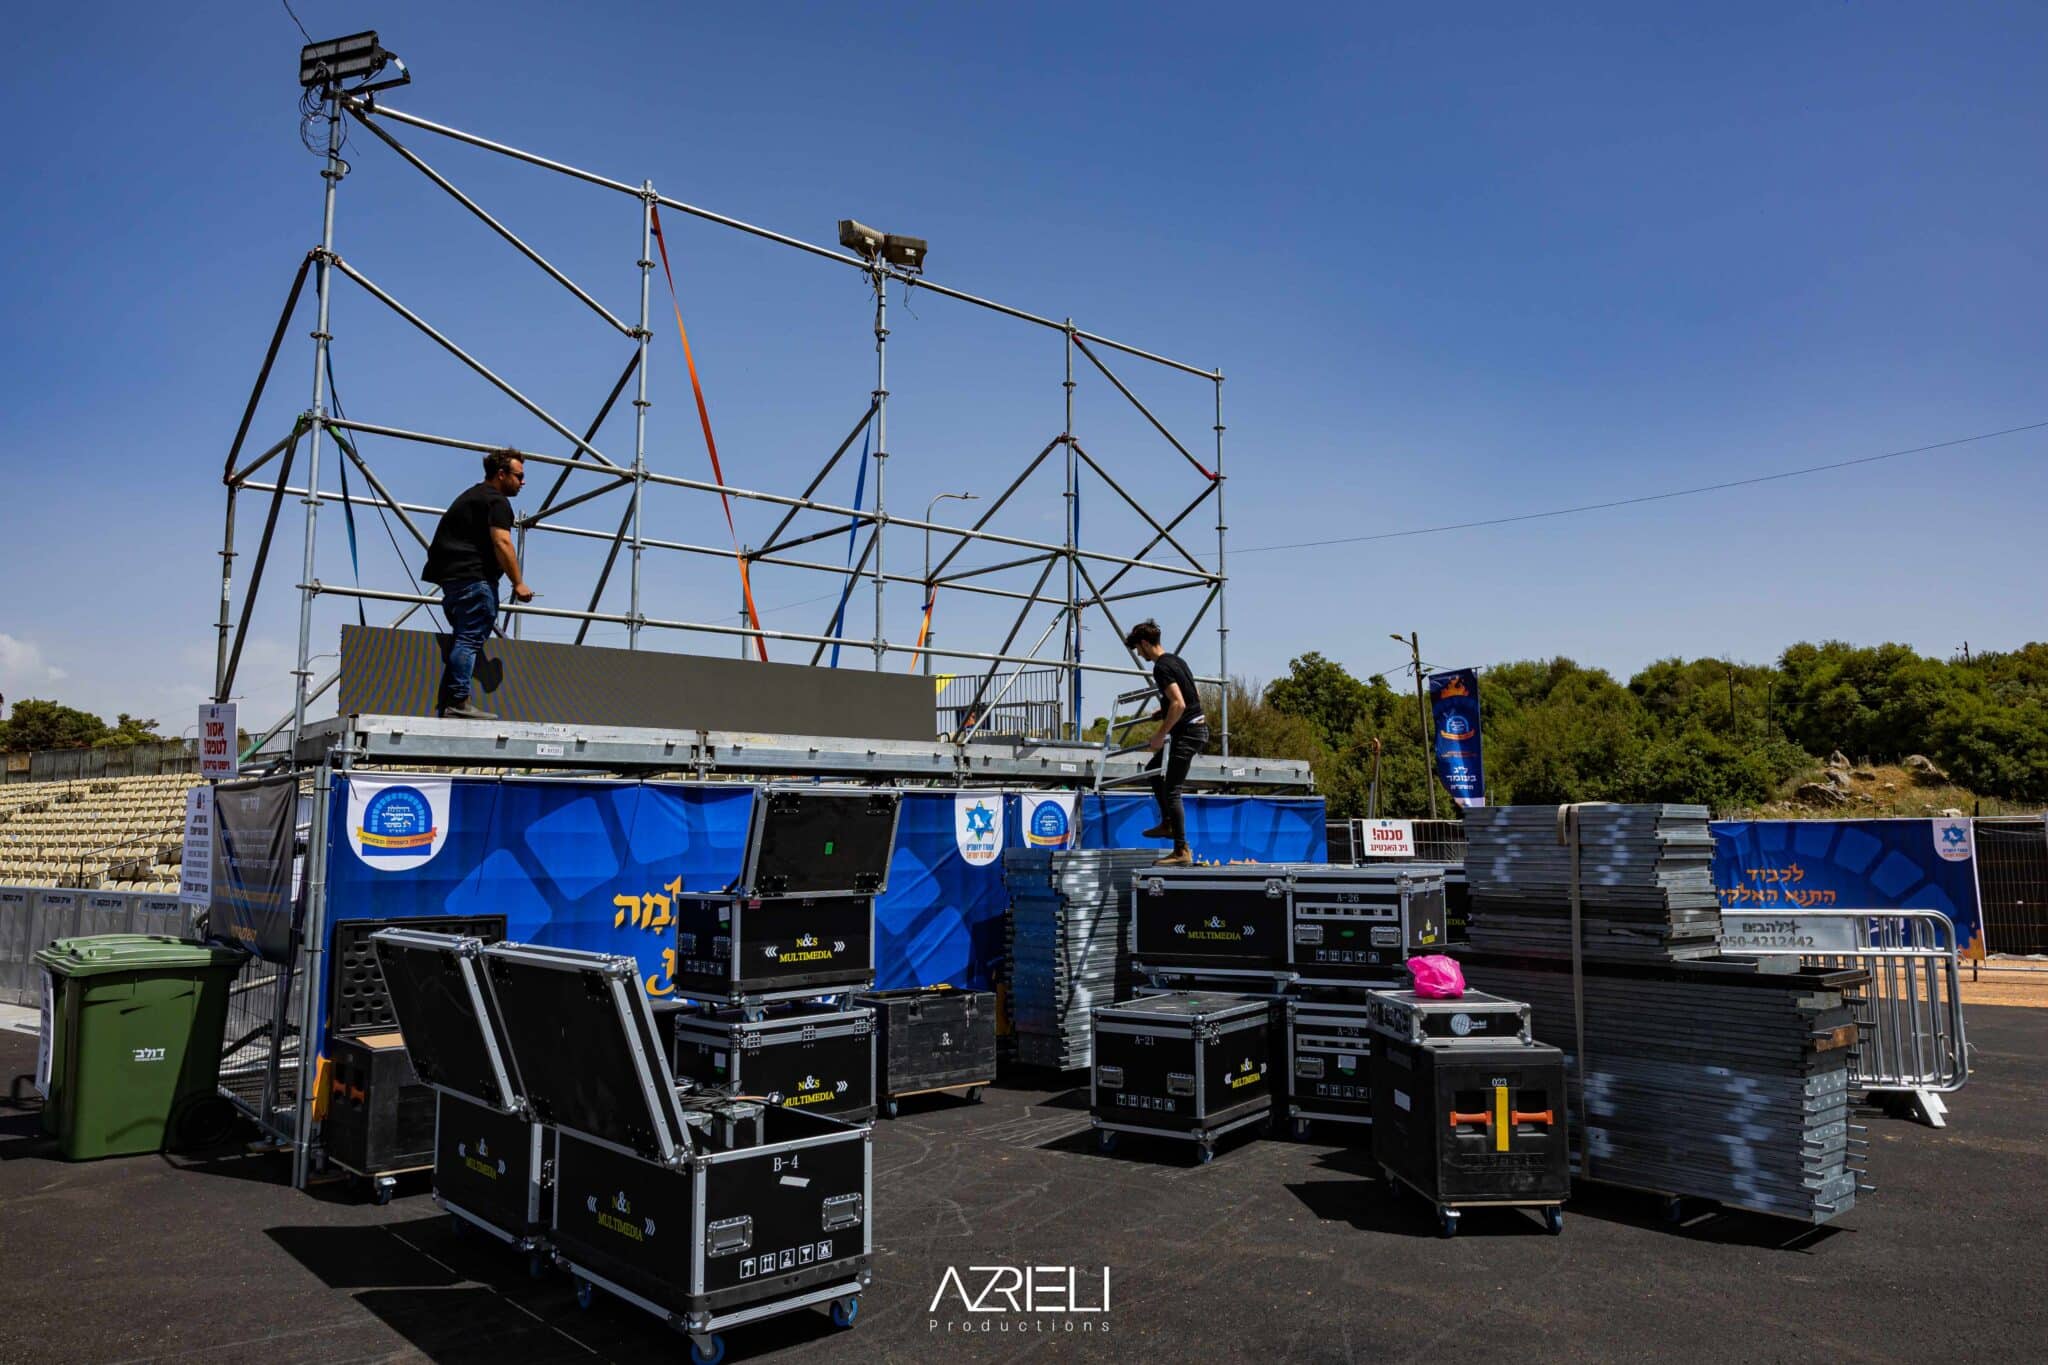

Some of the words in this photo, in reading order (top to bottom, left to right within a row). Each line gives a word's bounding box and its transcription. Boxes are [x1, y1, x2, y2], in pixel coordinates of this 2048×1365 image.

[206, 722, 225, 737] אסור
[1372, 828, 1403, 840] סכנה!
[1203, 916, 1226, 928] N&S
[796, 933, 818, 948] N&S
[1188, 931, 1241, 940] MULTIMEDIA
[779, 950, 832, 963] MULTIMEDIA
[798, 1075, 820, 1090] N&S
[783, 1091, 835, 1107] MULTIMEDIA
[773, 1155, 800, 1172] B-4
[612, 1191, 631, 1214] N&S
[598, 1211, 643, 1241] MULTIMEDIA
